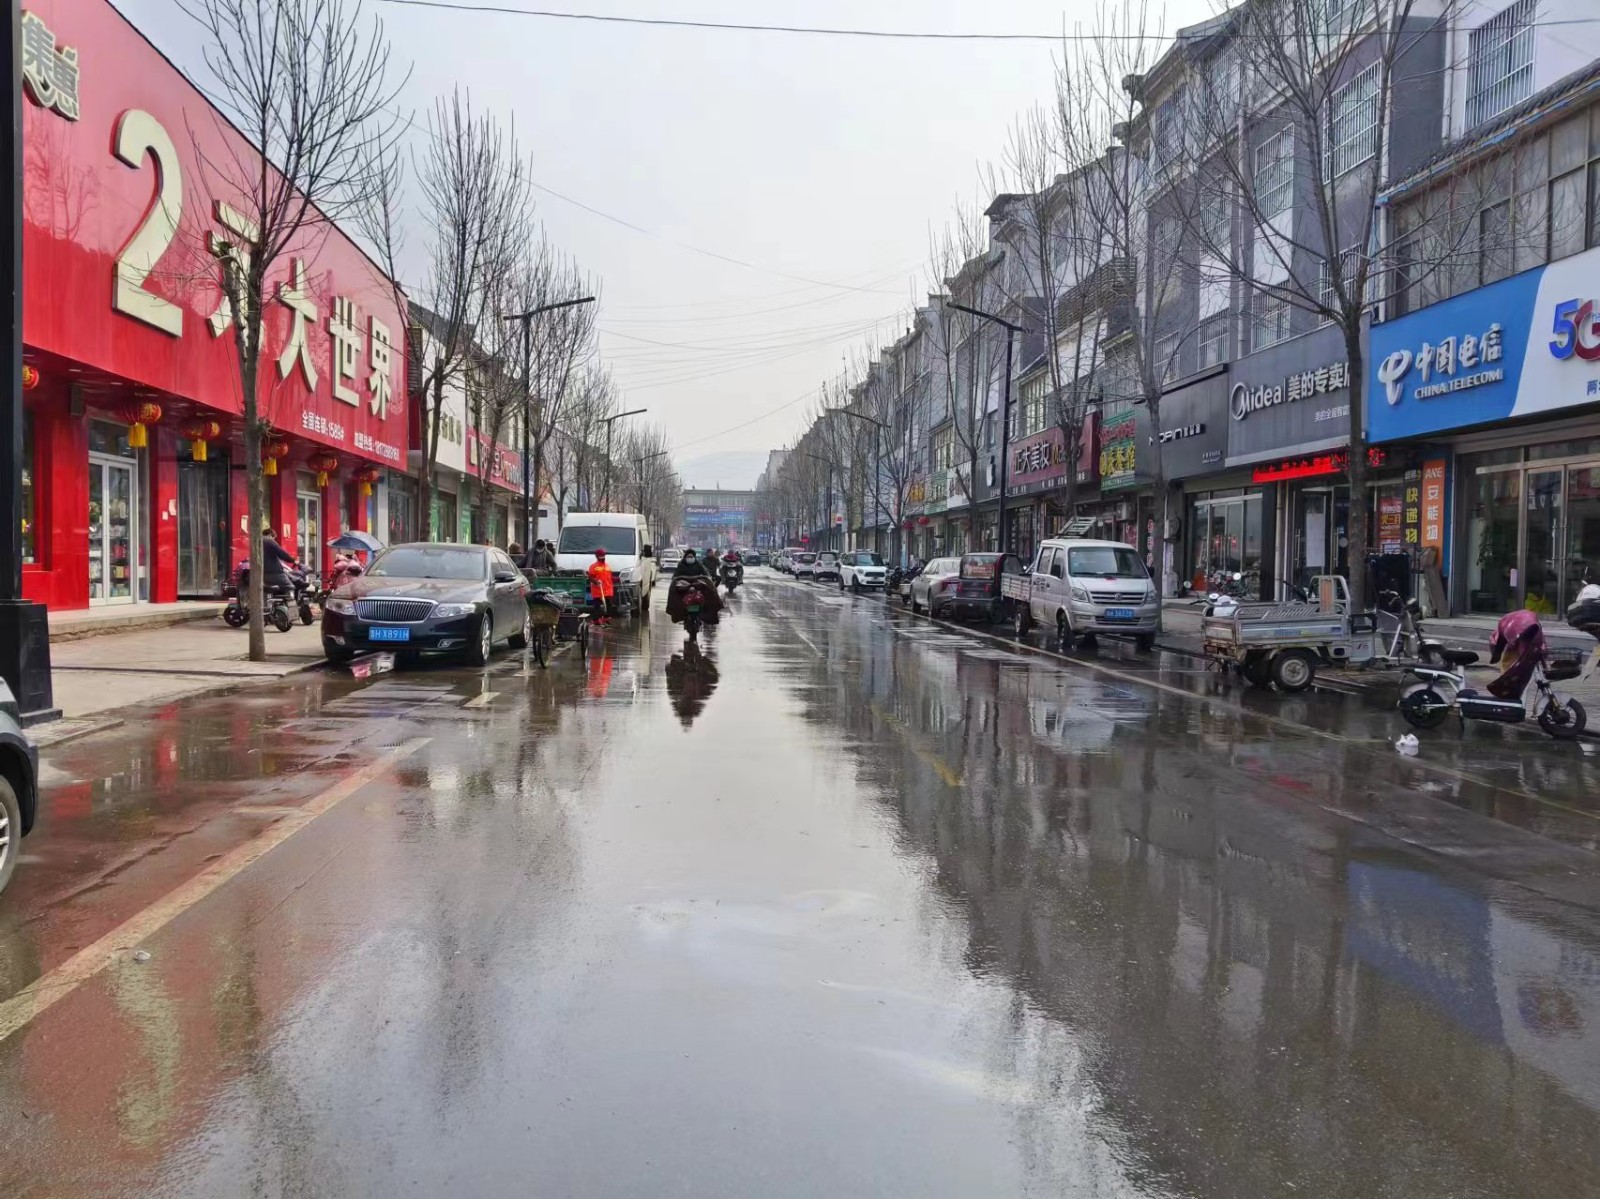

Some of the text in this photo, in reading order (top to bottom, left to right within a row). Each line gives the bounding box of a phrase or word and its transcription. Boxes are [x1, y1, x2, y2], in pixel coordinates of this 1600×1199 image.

[1549, 298, 1600, 360] 5G
[1415, 322, 1503, 382] 中国电信
[1231, 381, 1282, 421] Midea
[1414, 368, 1503, 399] CHINA TELECOM
[1587, 379, 1600, 396] 两
[1015, 440, 1050, 475] 正大美妆
[1405, 487, 1419, 544] 快递物
